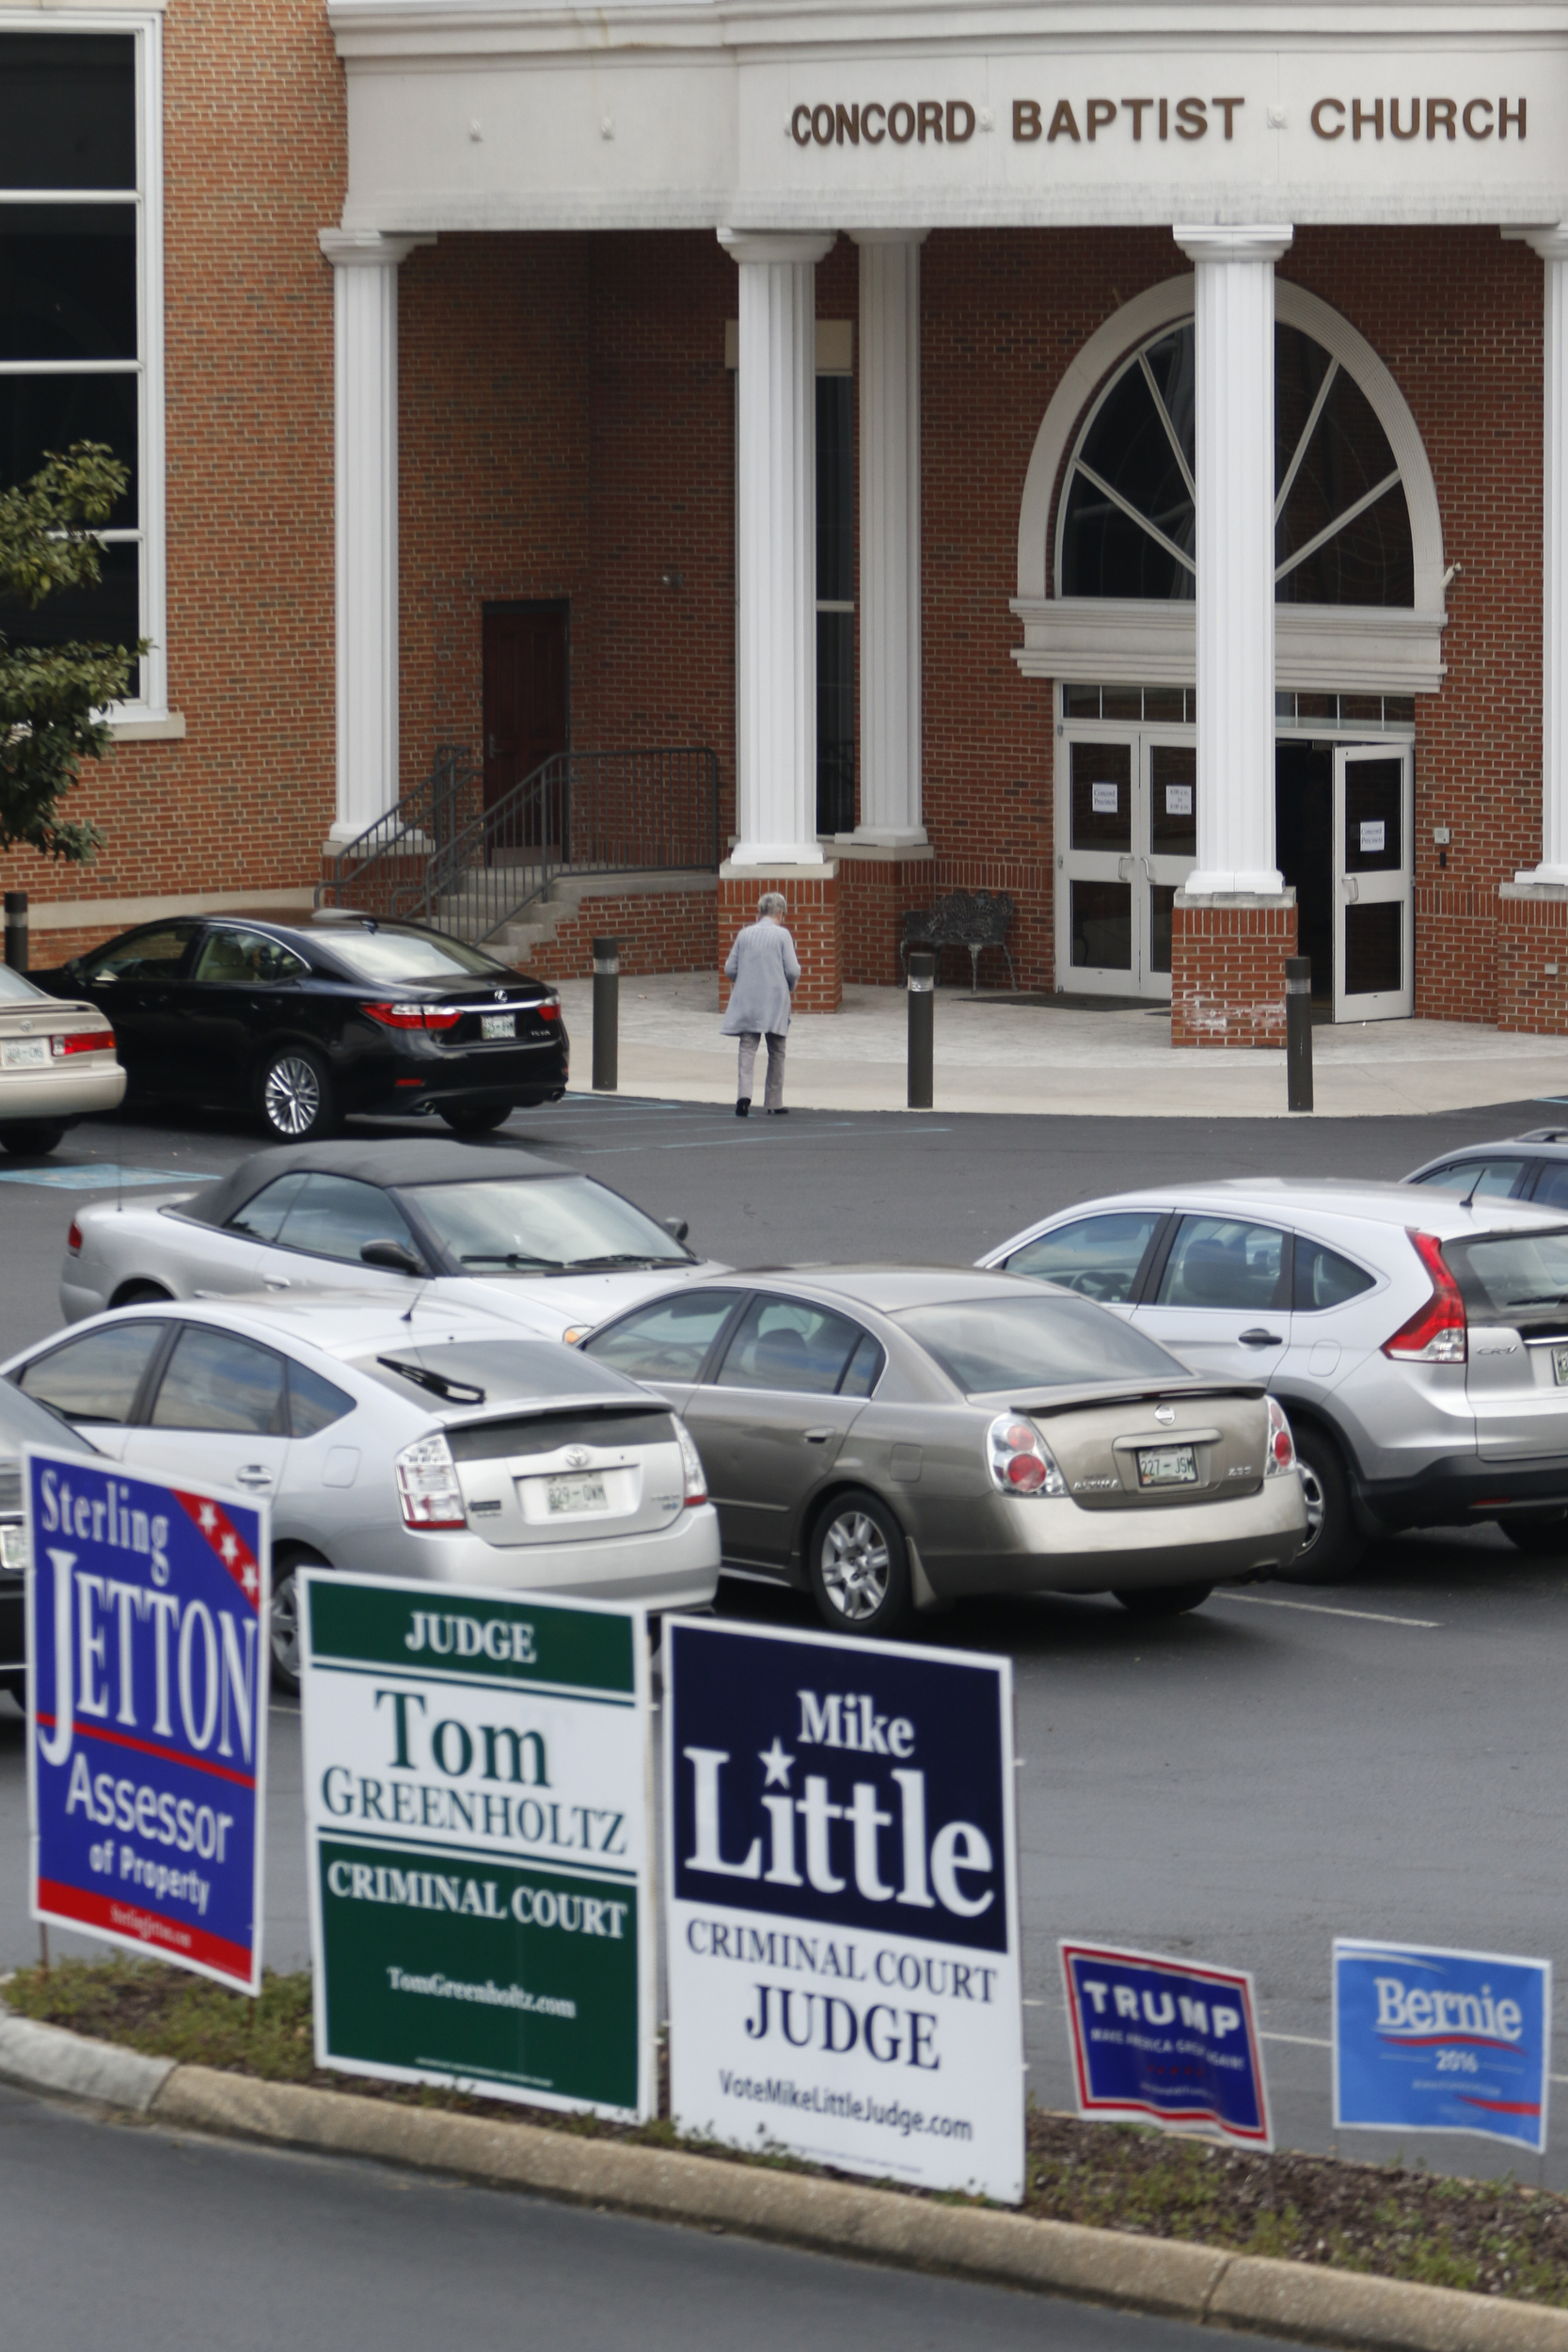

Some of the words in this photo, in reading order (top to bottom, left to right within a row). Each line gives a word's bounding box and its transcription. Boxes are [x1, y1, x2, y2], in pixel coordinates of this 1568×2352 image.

[791, 100, 976, 146] CONCORD
[1011, 97, 1245, 143] BAPTIST
[1309, 97, 1528, 141] CHURCH
[1477, 1344, 1517, 1355] CR-V
[40, 1468, 170, 1587] Sterling
[38, 1546, 258, 1767] JETTON
[404, 1611, 537, 1664] JUDGE
[374, 1688, 552, 1788] Tom
[797, 1690, 915, 1758] Mike
[66, 1753, 234, 1865] Assessor
[321, 1765, 628, 1856] GREENHOLTZ
[683, 1739, 995, 1918] Little
[90, 1839, 114, 1876] of
[119, 1845, 210, 1916] Property
[327, 1860, 508, 1920] CRIMINAL
[512, 1886, 628, 1939] COURT
[387, 1966, 577, 2019] TomGreenholtz.com
[686, 1917, 866, 1982] CRIMINAL
[874, 1949, 998, 2004] COURT
[744, 1984, 941, 2072] JUDGE
[1082, 1979, 1241, 2040] TRUMP
[1372, 1977, 1523, 2042] Bernie
[1434, 2049, 1479, 2074] 2016
[719, 2069, 974, 2141] VoteMikeLittleJudge.com
